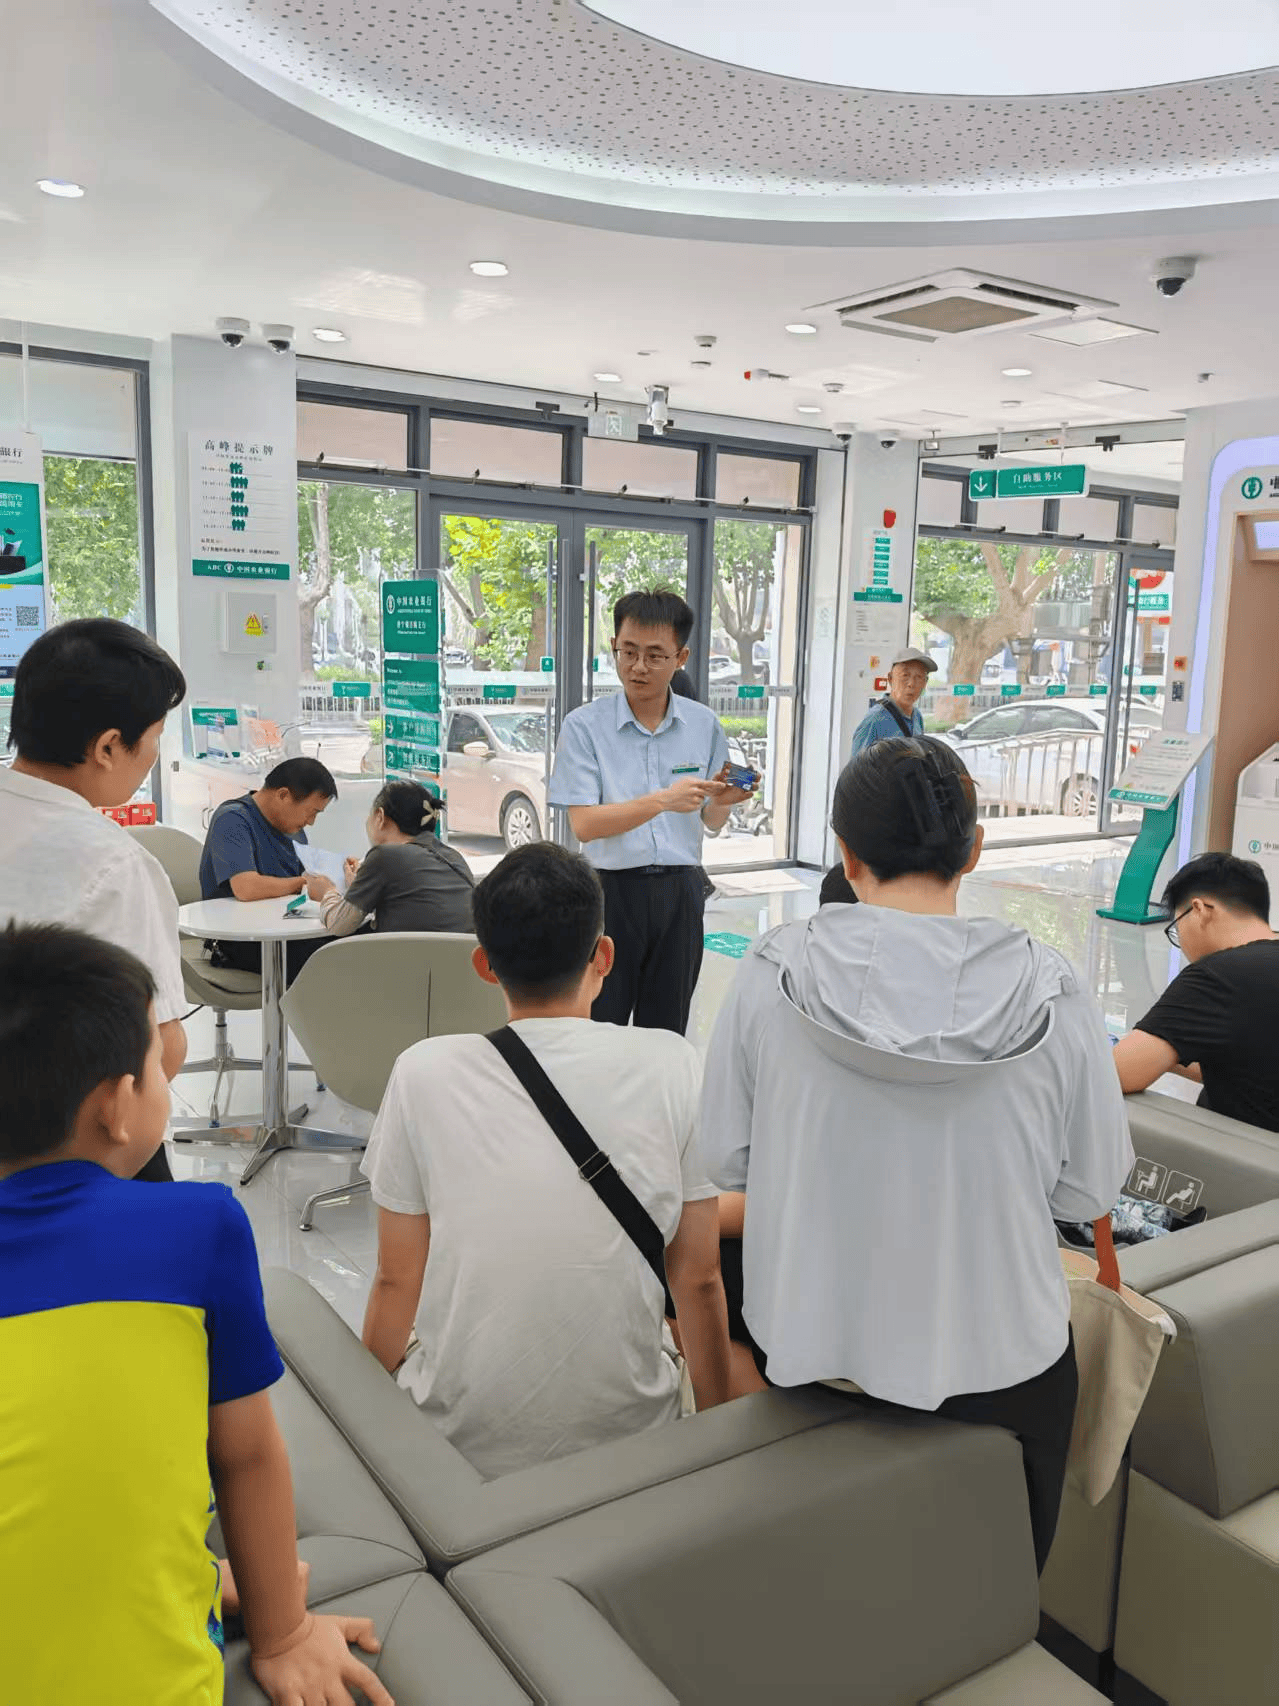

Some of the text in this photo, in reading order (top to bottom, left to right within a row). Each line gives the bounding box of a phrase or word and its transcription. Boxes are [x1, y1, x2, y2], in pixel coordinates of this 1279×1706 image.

[205, 439, 273, 456] 高峰提示牌
[1013, 471, 1063, 484] 自助服务区
[237, 566, 278, 575] 中国农业银行
[396, 595, 432, 606] 中国农业银行
